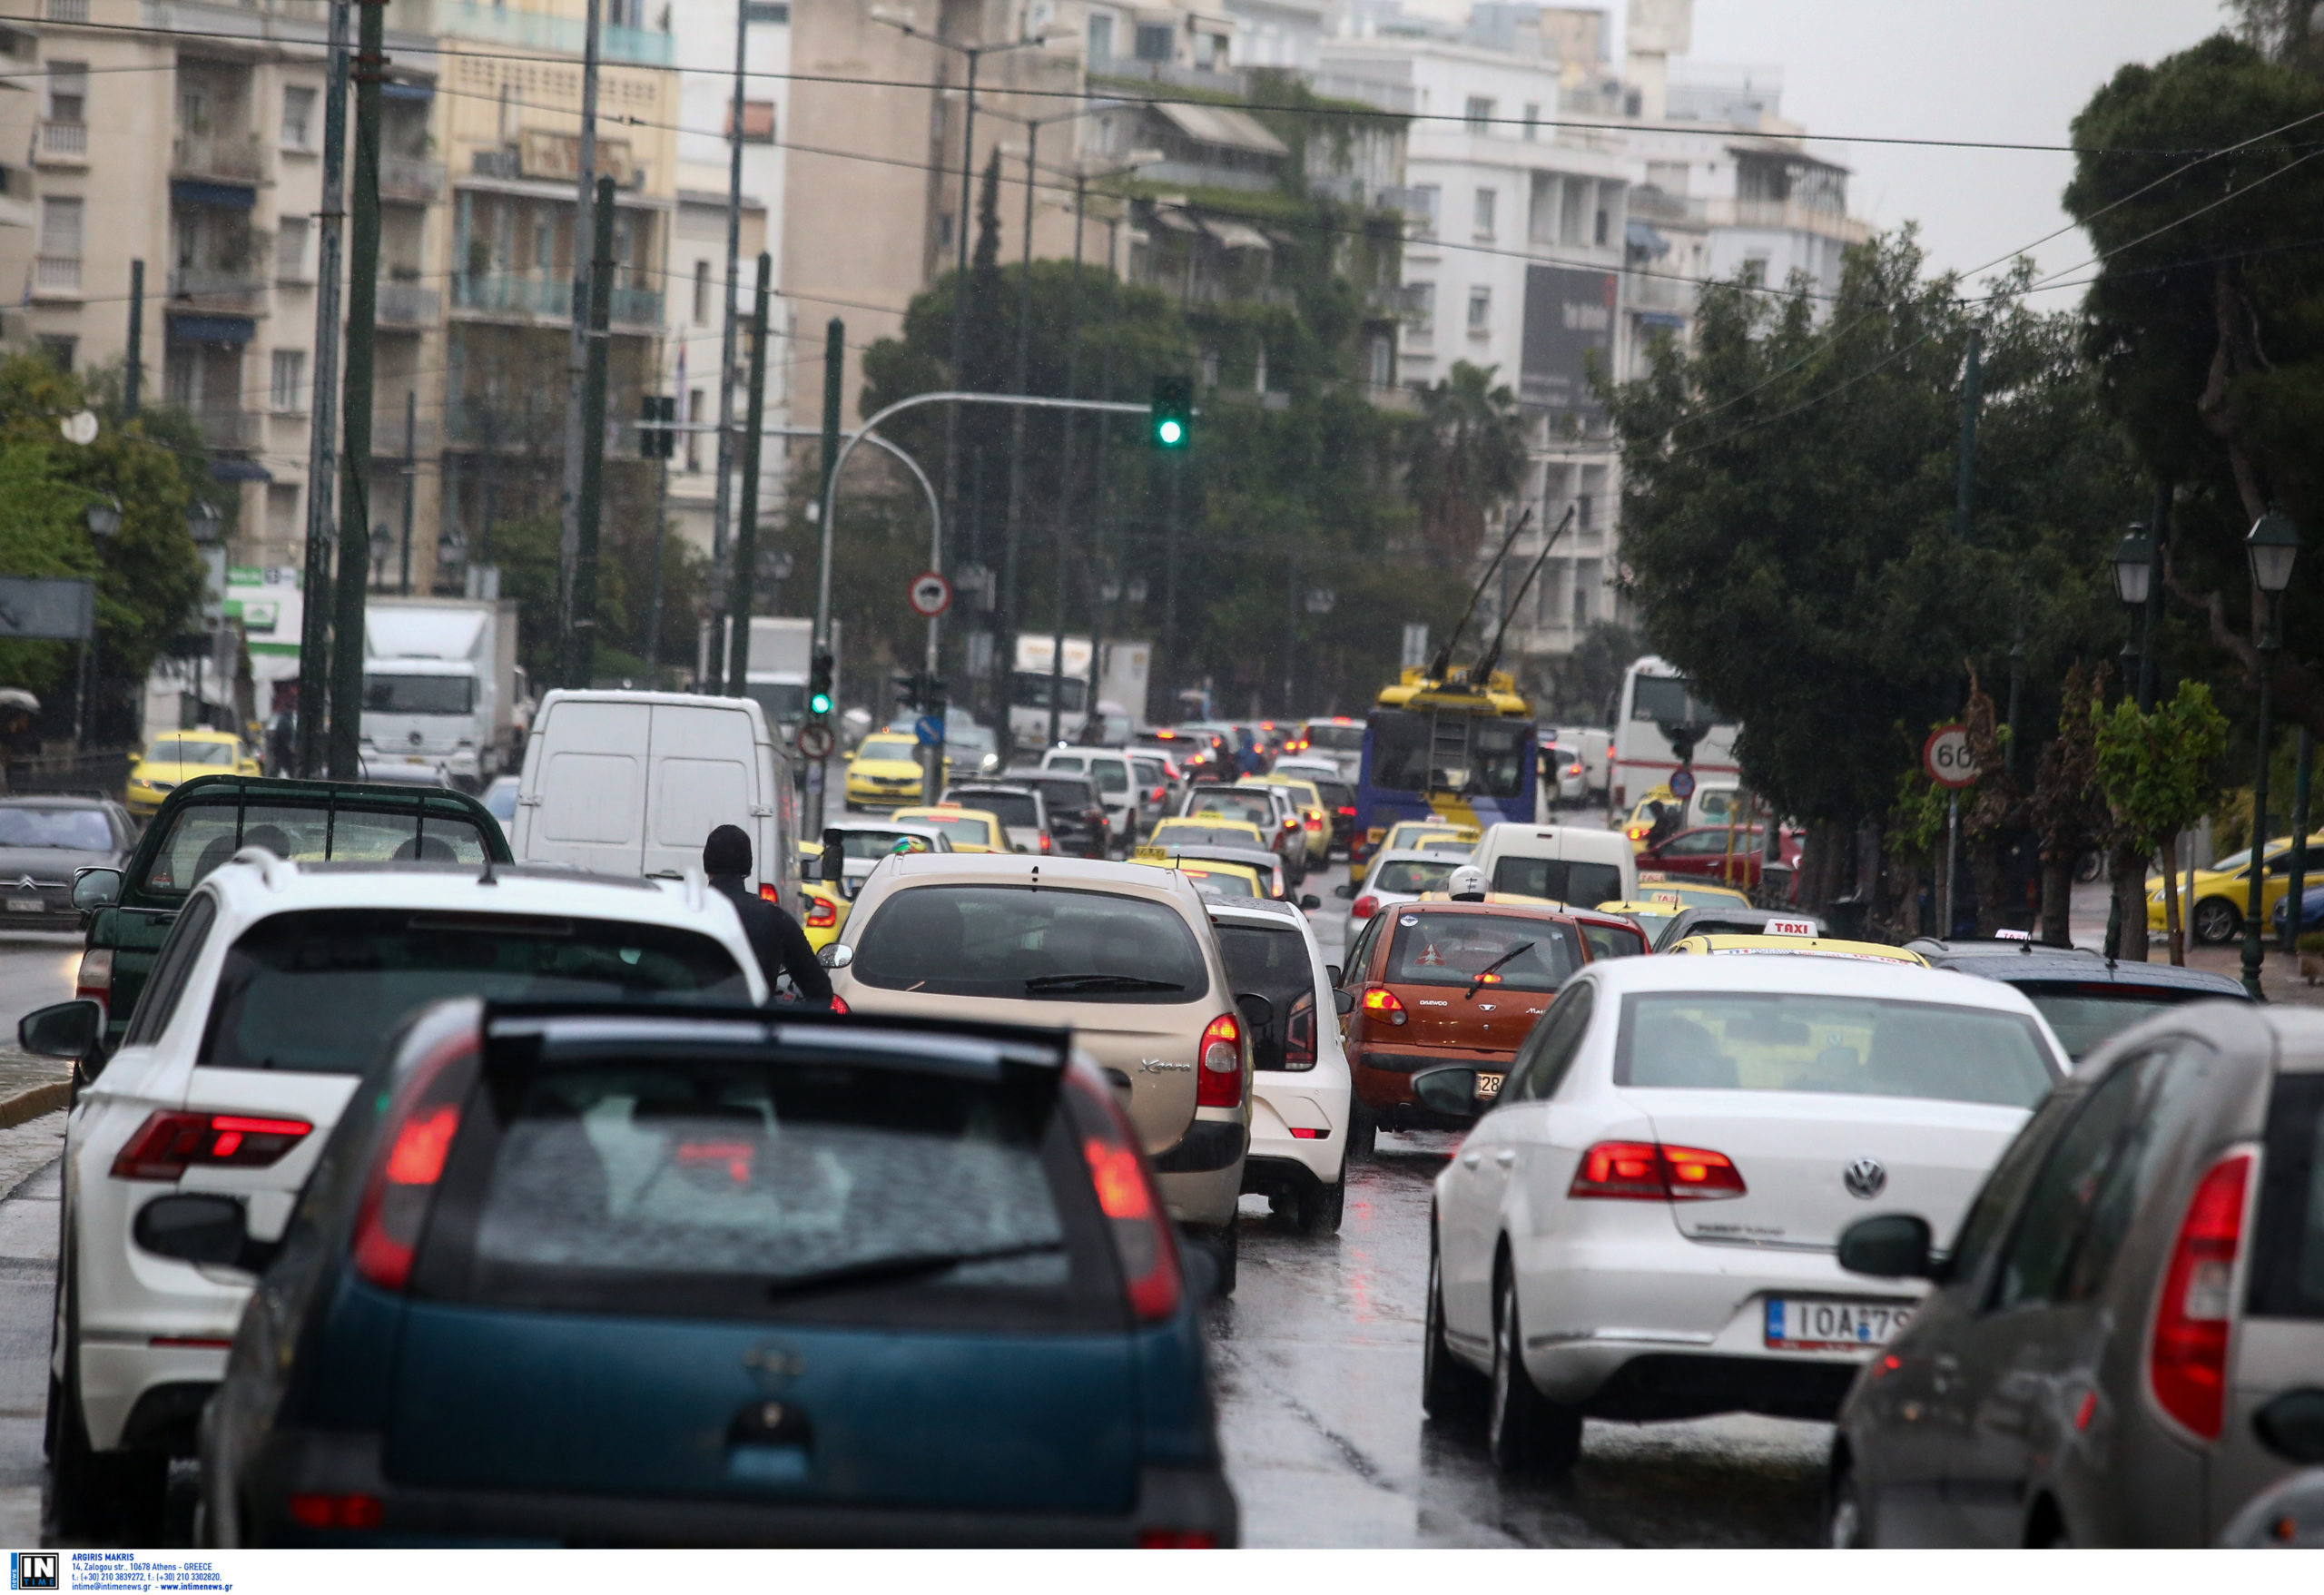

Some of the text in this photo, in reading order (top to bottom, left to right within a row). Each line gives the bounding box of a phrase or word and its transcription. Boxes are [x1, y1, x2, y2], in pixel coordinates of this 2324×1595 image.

[1938, 744, 1972, 768] 60
[1775, 922, 1808, 934] TAXI
[1482, 1076, 1500, 1092] 28
